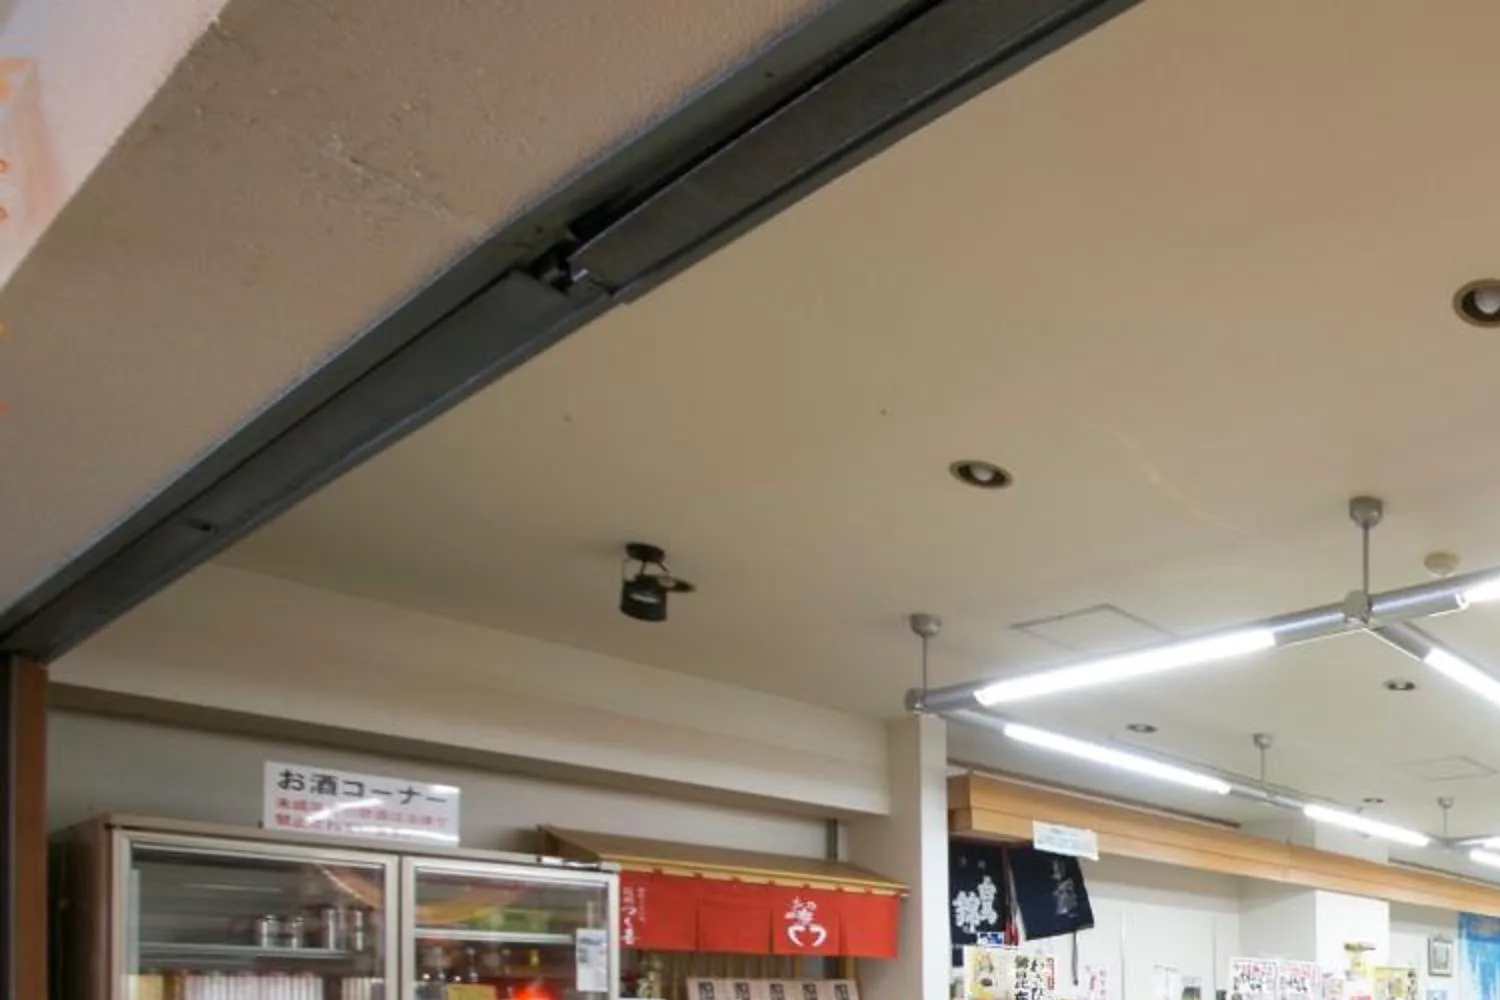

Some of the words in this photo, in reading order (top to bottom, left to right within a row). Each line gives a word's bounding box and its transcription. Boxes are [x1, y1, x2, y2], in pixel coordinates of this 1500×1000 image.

[276, 769, 447, 805] お酒コーナー
